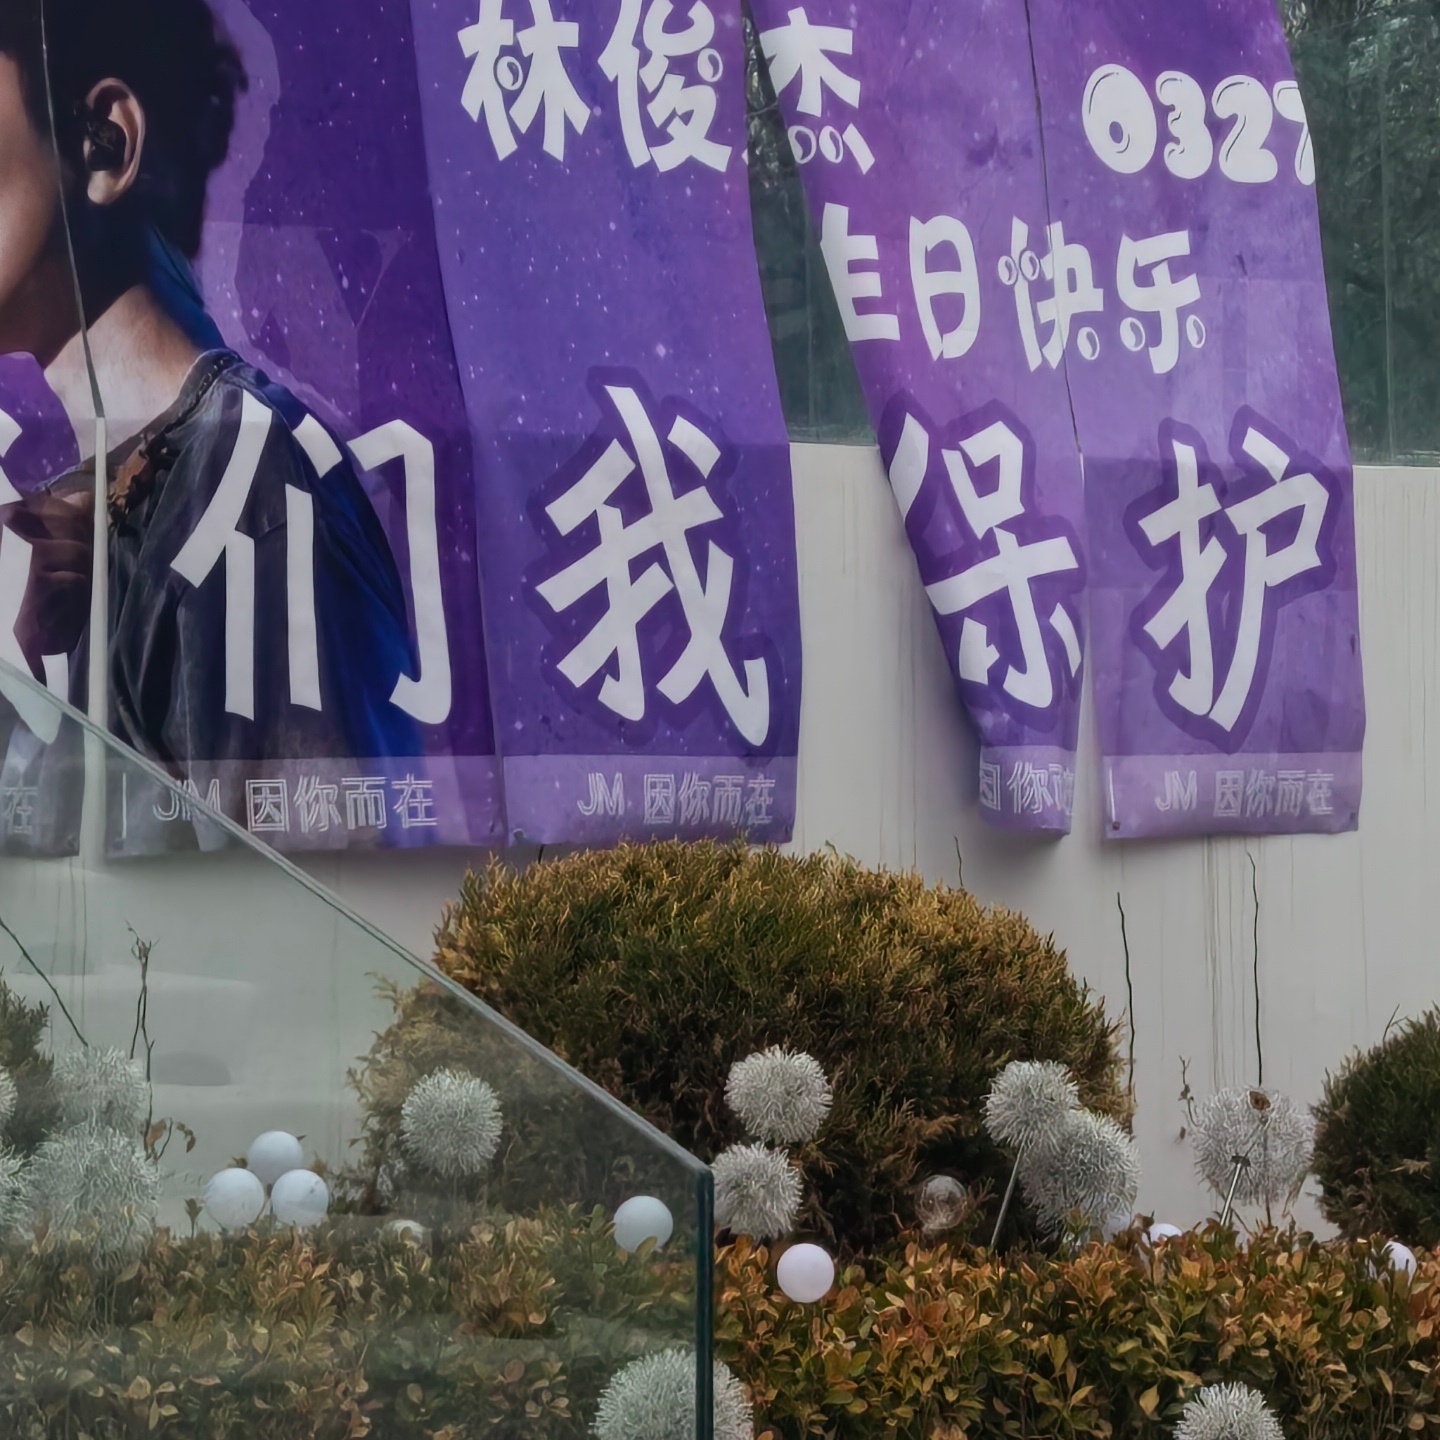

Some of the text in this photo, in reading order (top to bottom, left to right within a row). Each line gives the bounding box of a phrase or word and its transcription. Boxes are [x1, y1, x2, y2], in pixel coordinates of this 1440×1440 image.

[819, 201, 1206, 374] 生日快乐
[245, 773, 438, 833] 因你而在
[576, 772, 776, 825] JM 因你而在
[1154, 768, 1335, 817] JM 因你而在
